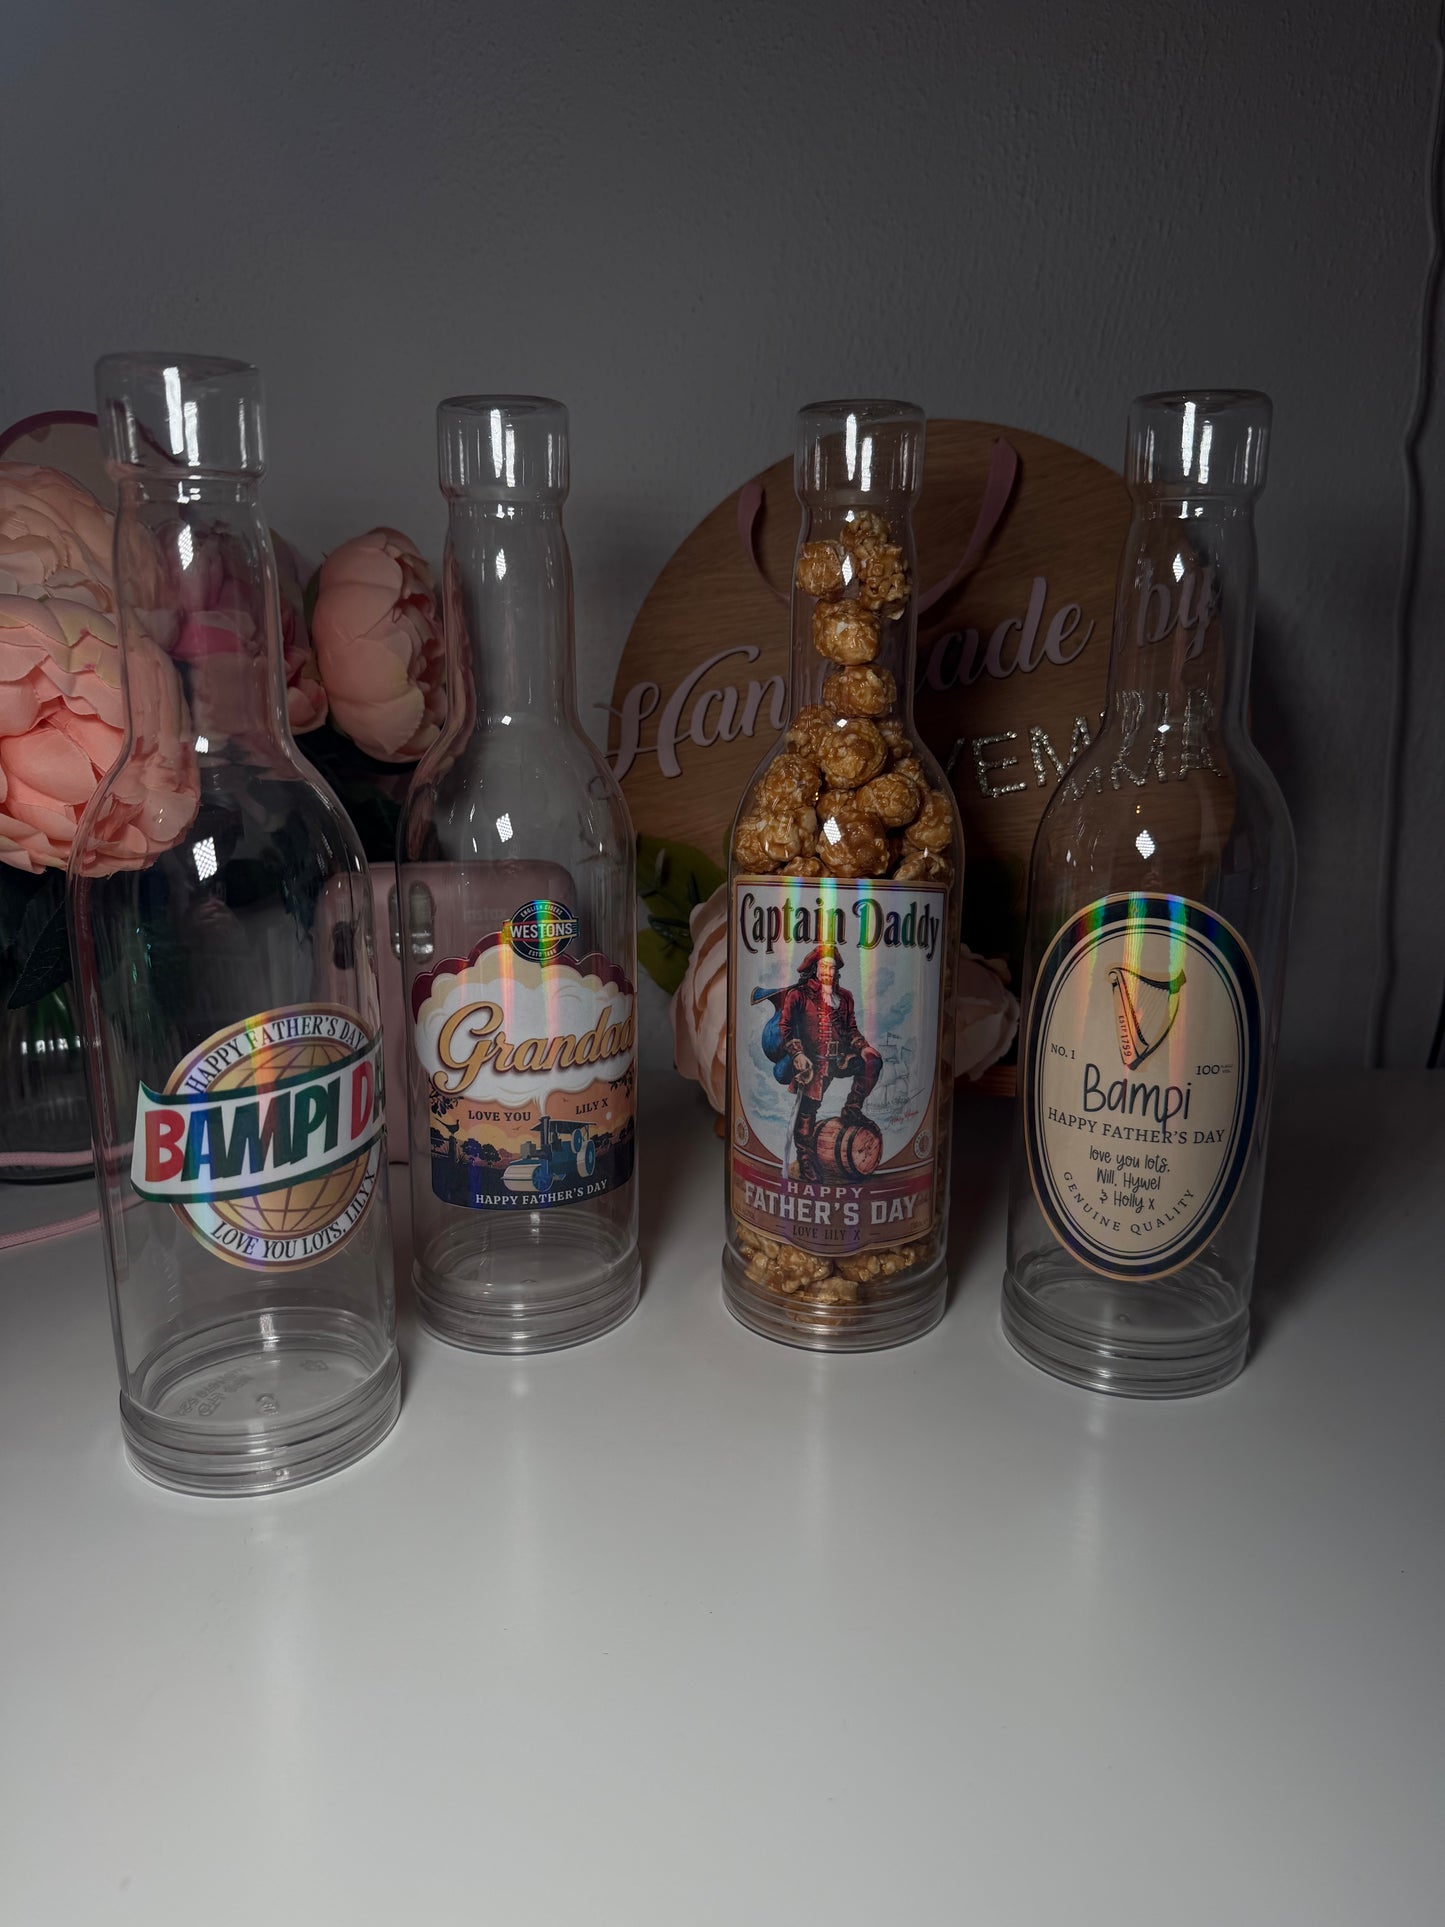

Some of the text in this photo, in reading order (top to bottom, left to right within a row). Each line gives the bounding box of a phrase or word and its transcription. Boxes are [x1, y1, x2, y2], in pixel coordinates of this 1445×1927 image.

[510, 922, 573, 939] WESTONS
[740, 893, 940, 962] Captain Daddy
[186, 1016, 365, 1094] HAPPY FATHER'S DAY
[432, 1000, 635, 1094] Grandad
[1050, 1043, 1076, 1060] NO. 1
[1120, 1034, 1132, 1057] 1759
[1196, 1064, 1220, 1076] 100
[575, 1097, 609, 1115] LILY X
[1083, 1063, 1192, 1136] Bampi
[468, 1109, 531, 1122] LOVE YOU
[1048, 1107, 1226, 1145] HAPPY FATHER'S DAY
[144, 1076, 341, 1183] BAMPI
[1089, 1145, 1112, 1163] love
[1116, 1154, 1140, 1171] you
[475, 1193, 518, 1206] HAPPY
[586, 1179, 608, 1195] DAY
[787, 1181, 865, 1199] HAPPY
[1123, 1171, 1161, 1194] Hywel
[744, 1181, 918, 1226] FATHER'S DAY
[1063, 1171, 1195, 1236] GENUINE QUALITY
[1113, 1189, 1145, 1214] Holly
[210, 1222, 259, 1256] LOVE
[262, 1239, 297, 1260] YOU
[345, 1183, 370, 1225] LILY
[792, 1224, 861, 1241] LOVE LILY X
